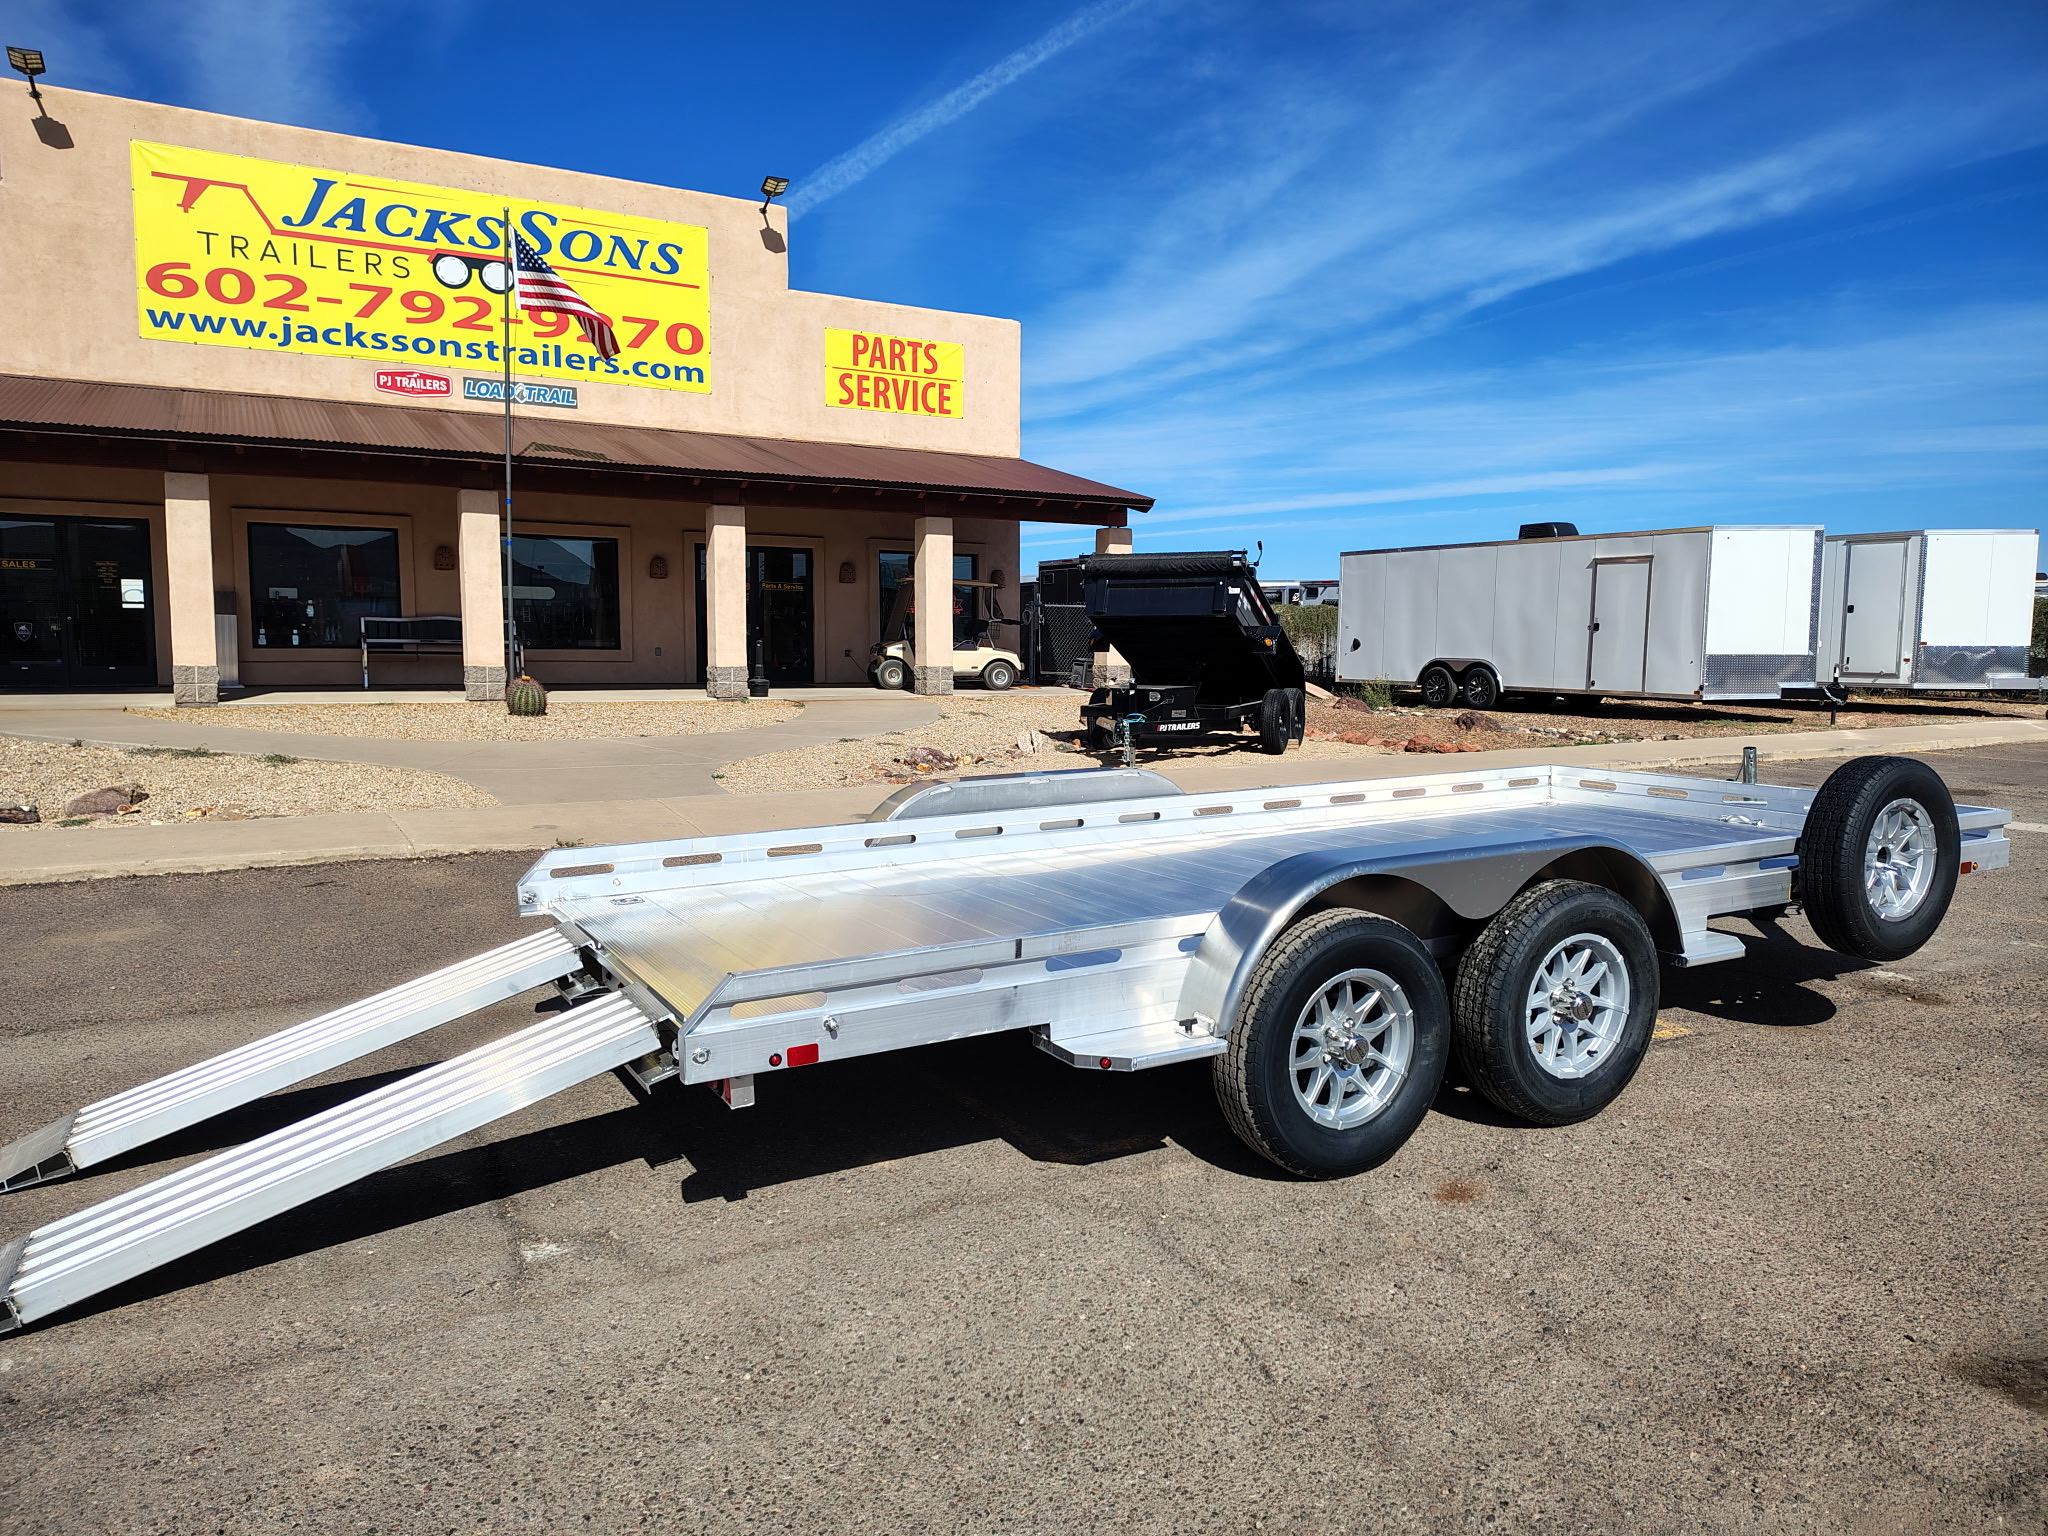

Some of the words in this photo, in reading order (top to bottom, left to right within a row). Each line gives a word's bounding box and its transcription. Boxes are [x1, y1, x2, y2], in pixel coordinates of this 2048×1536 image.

[196, 230, 410, 279] TRAILERS
[146, 309, 704, 383] www.jackssonstrailers.com
[852, 334, 938, 374] PARTS
[379, 375, 392, 386] PJ
[395, 376, 447, 391] TRAILERS
[465, 380, 515, 400] LOAD
[524, 385, 577, 405] TRAIL
[838, 372, 951, 414] SERVICE
[1, 560, 36, 568] SALES
[1168, 722, 1200, 731] TRAILERS
